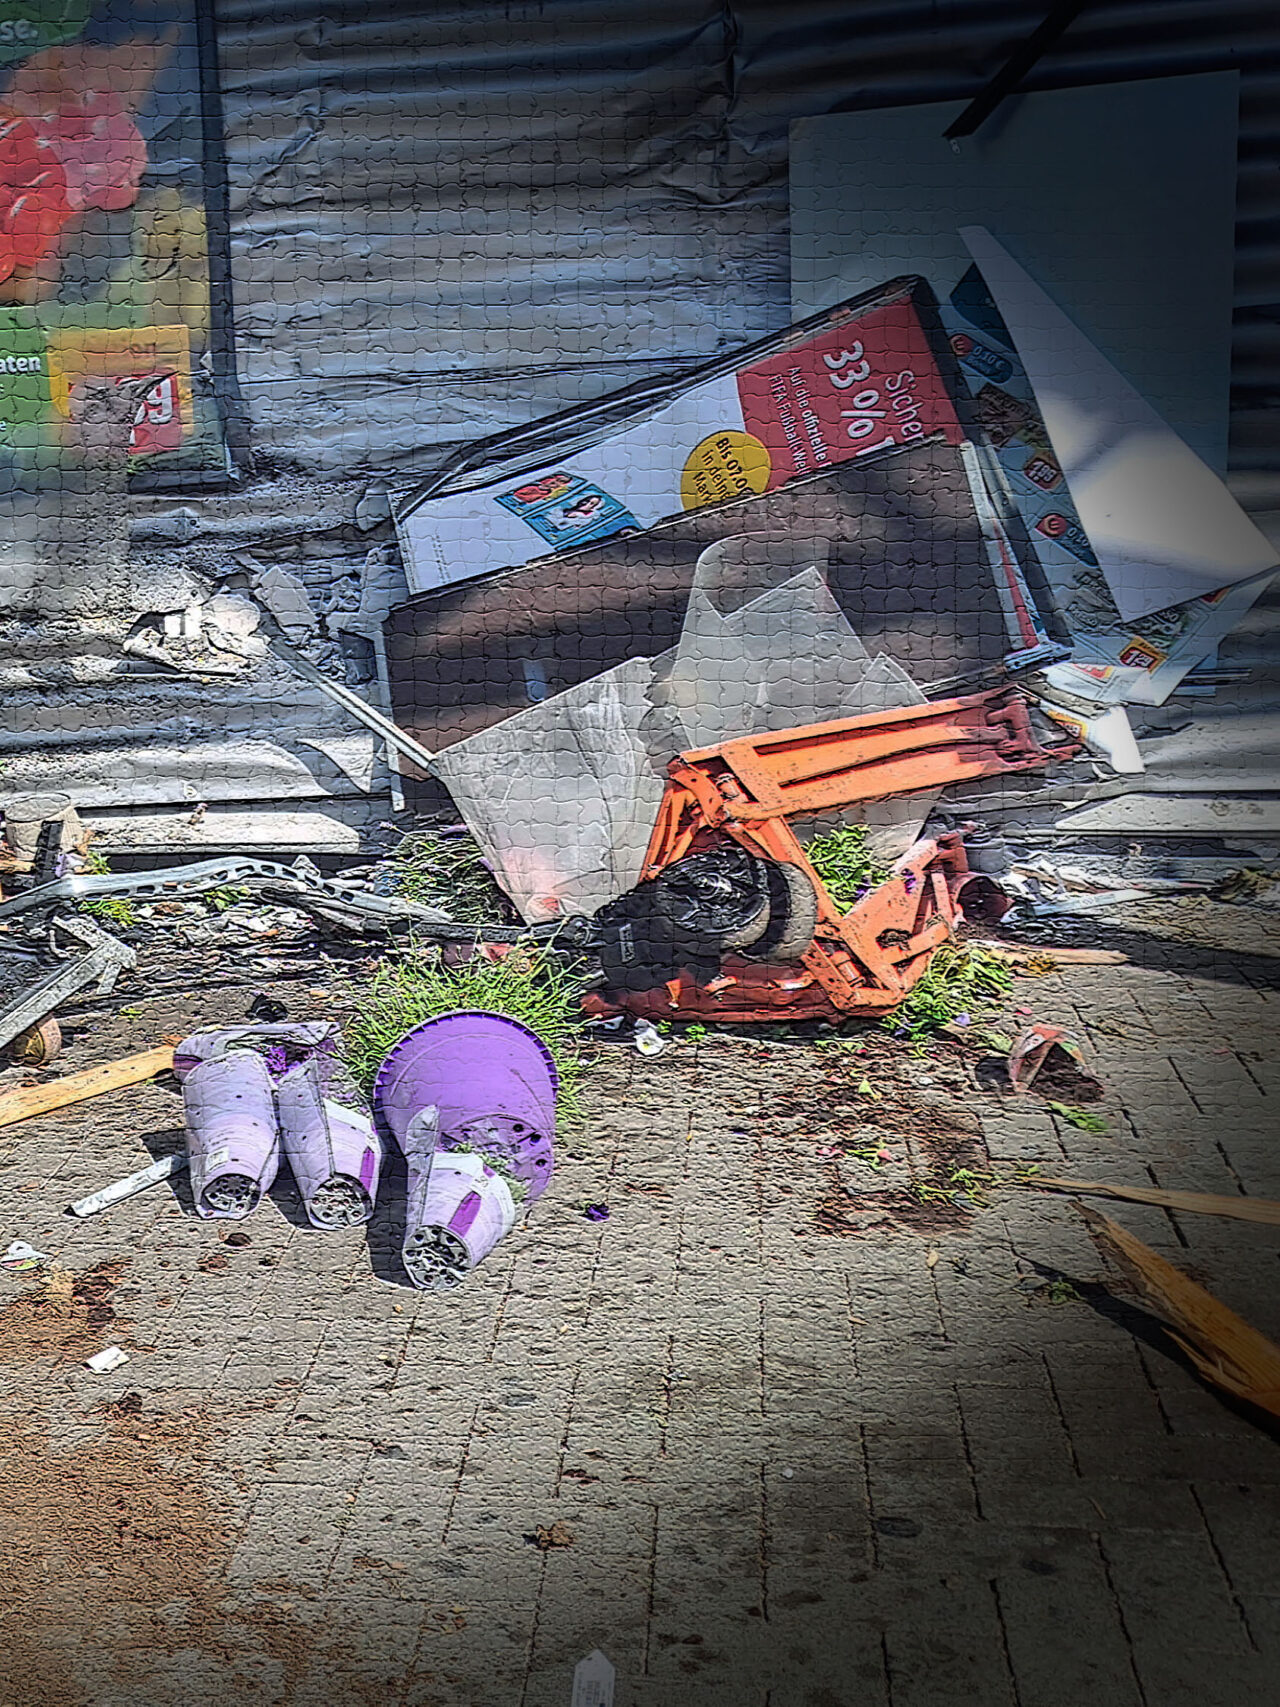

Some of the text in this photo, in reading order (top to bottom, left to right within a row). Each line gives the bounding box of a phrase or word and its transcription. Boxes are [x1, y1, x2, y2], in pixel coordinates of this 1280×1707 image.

[787, 367, 807, 387] Auf
[823, 340, 871, 389] 33
[768, 374, 789, 404] FIFA
[795, 389, 811, 409] die
[840, 389, 887, 438] %
[885, 370, 925, 441] Sicher
[715, 437, 732, 460] Bis
[801, 409, 829, 463] offizielle
[701, 449, 714, 466] in
